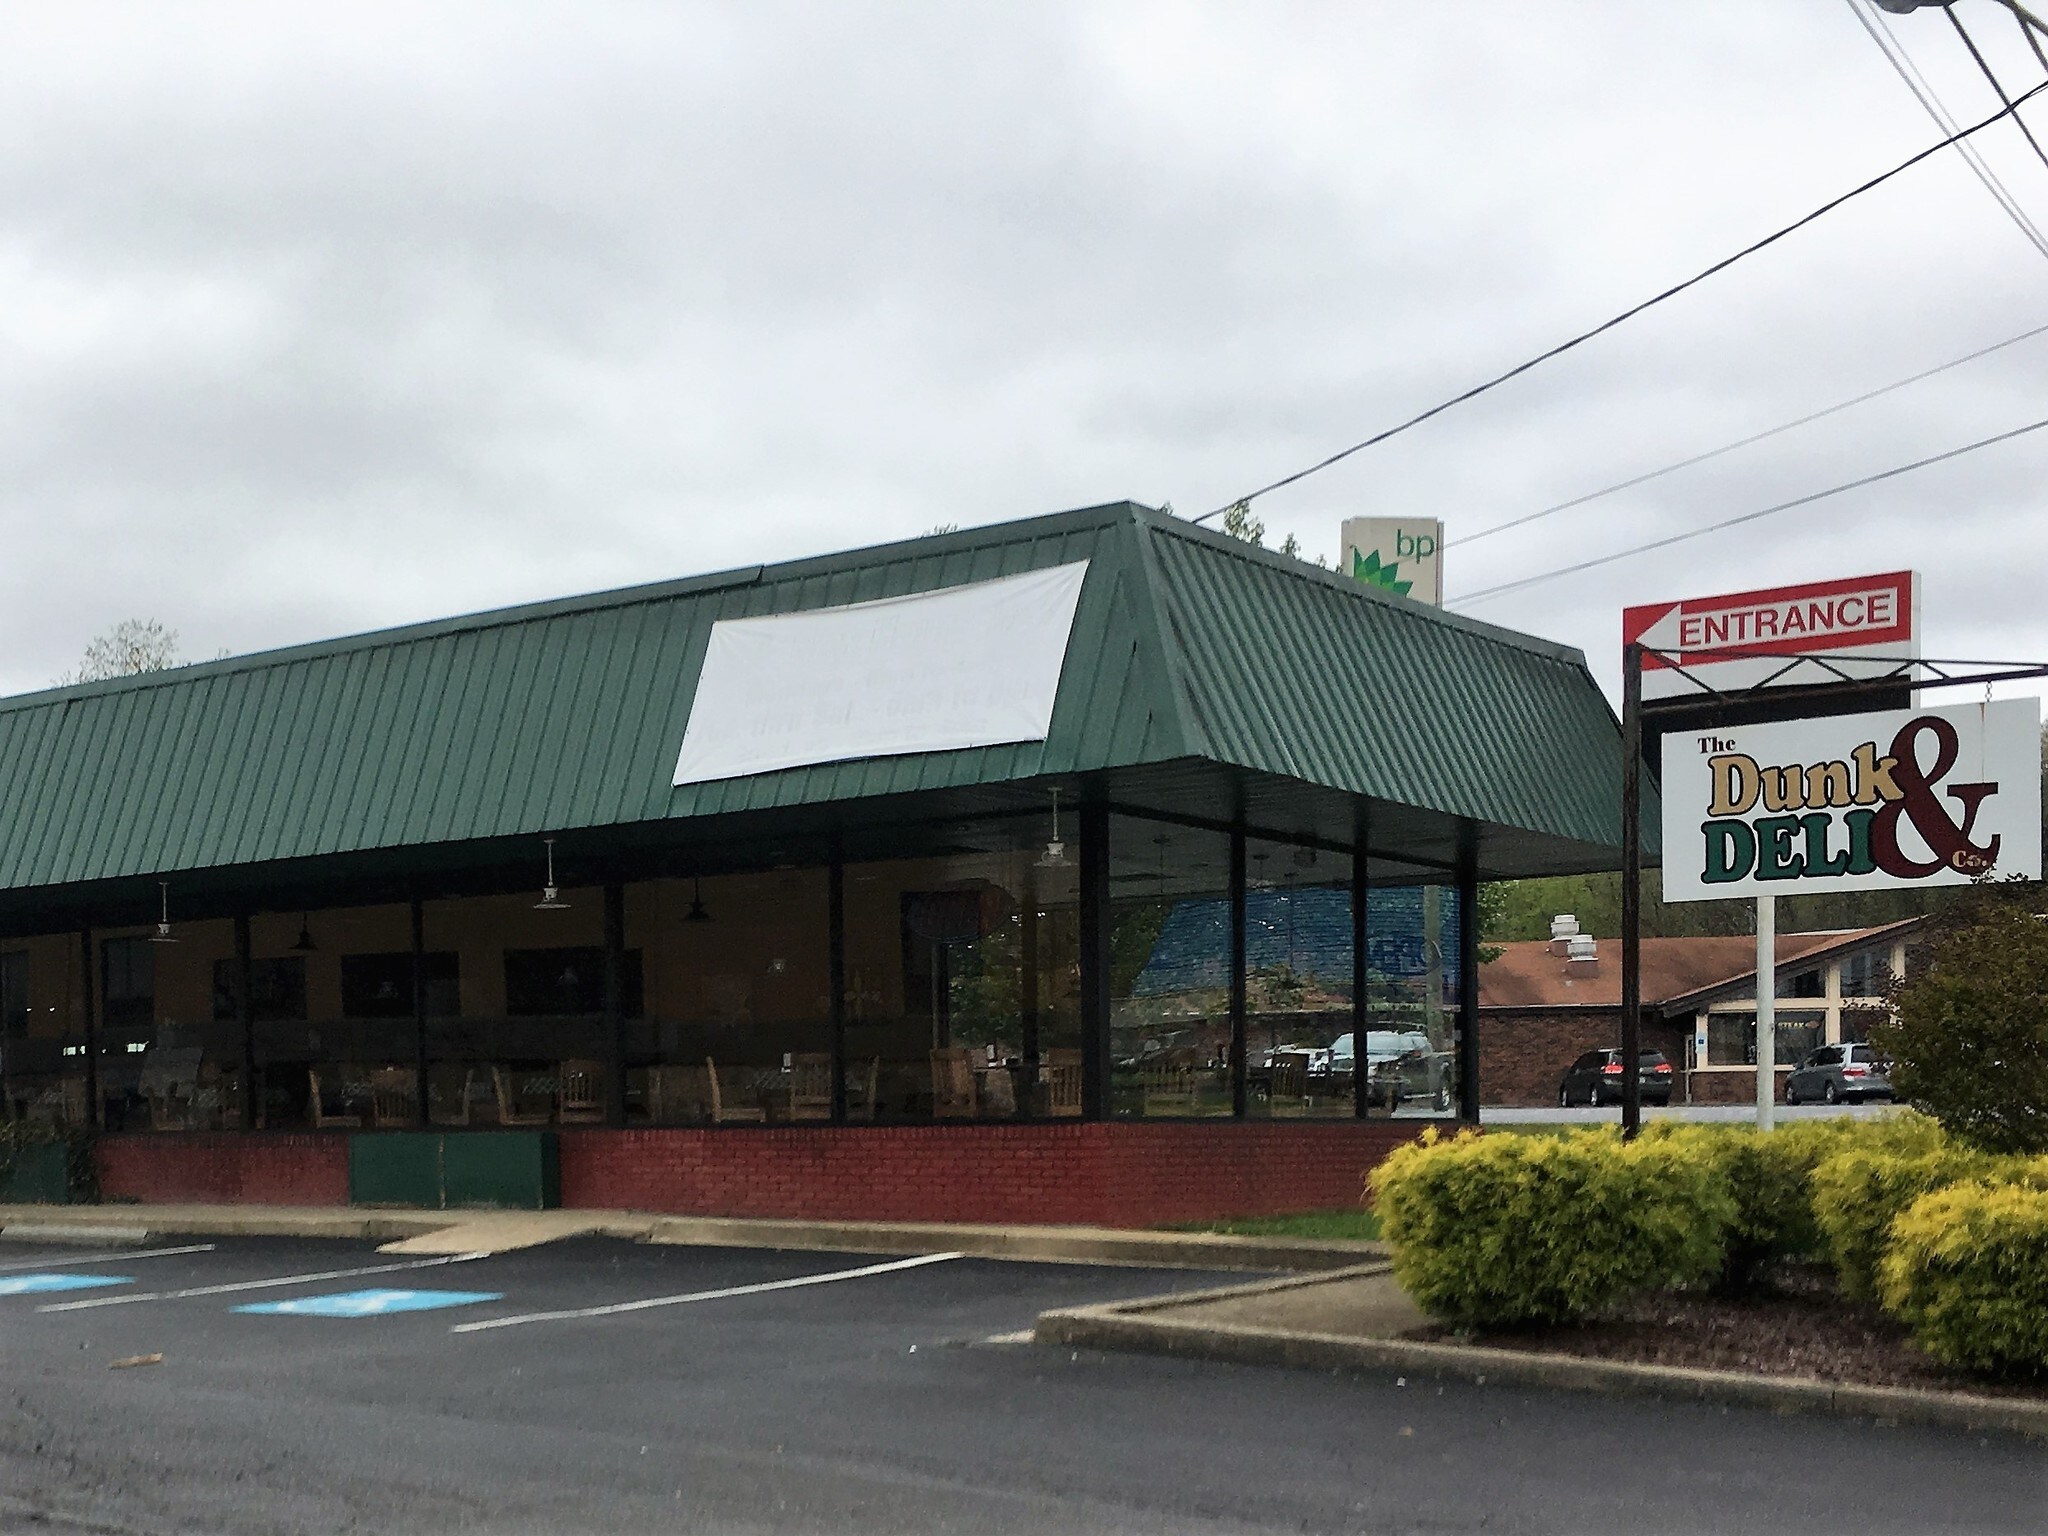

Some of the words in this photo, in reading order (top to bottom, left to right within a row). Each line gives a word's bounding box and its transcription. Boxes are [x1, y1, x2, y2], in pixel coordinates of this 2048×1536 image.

[1396, 528, 1435, 564] bp
[1680, 594, 1891, 646] ENTRANCE
[1698, 737, 1736, 754] The
[1707, 742, 1904, 816] Dunk
[1871, 716, 2000, 880] &
[1700, 809, 1879, 885] DELI
